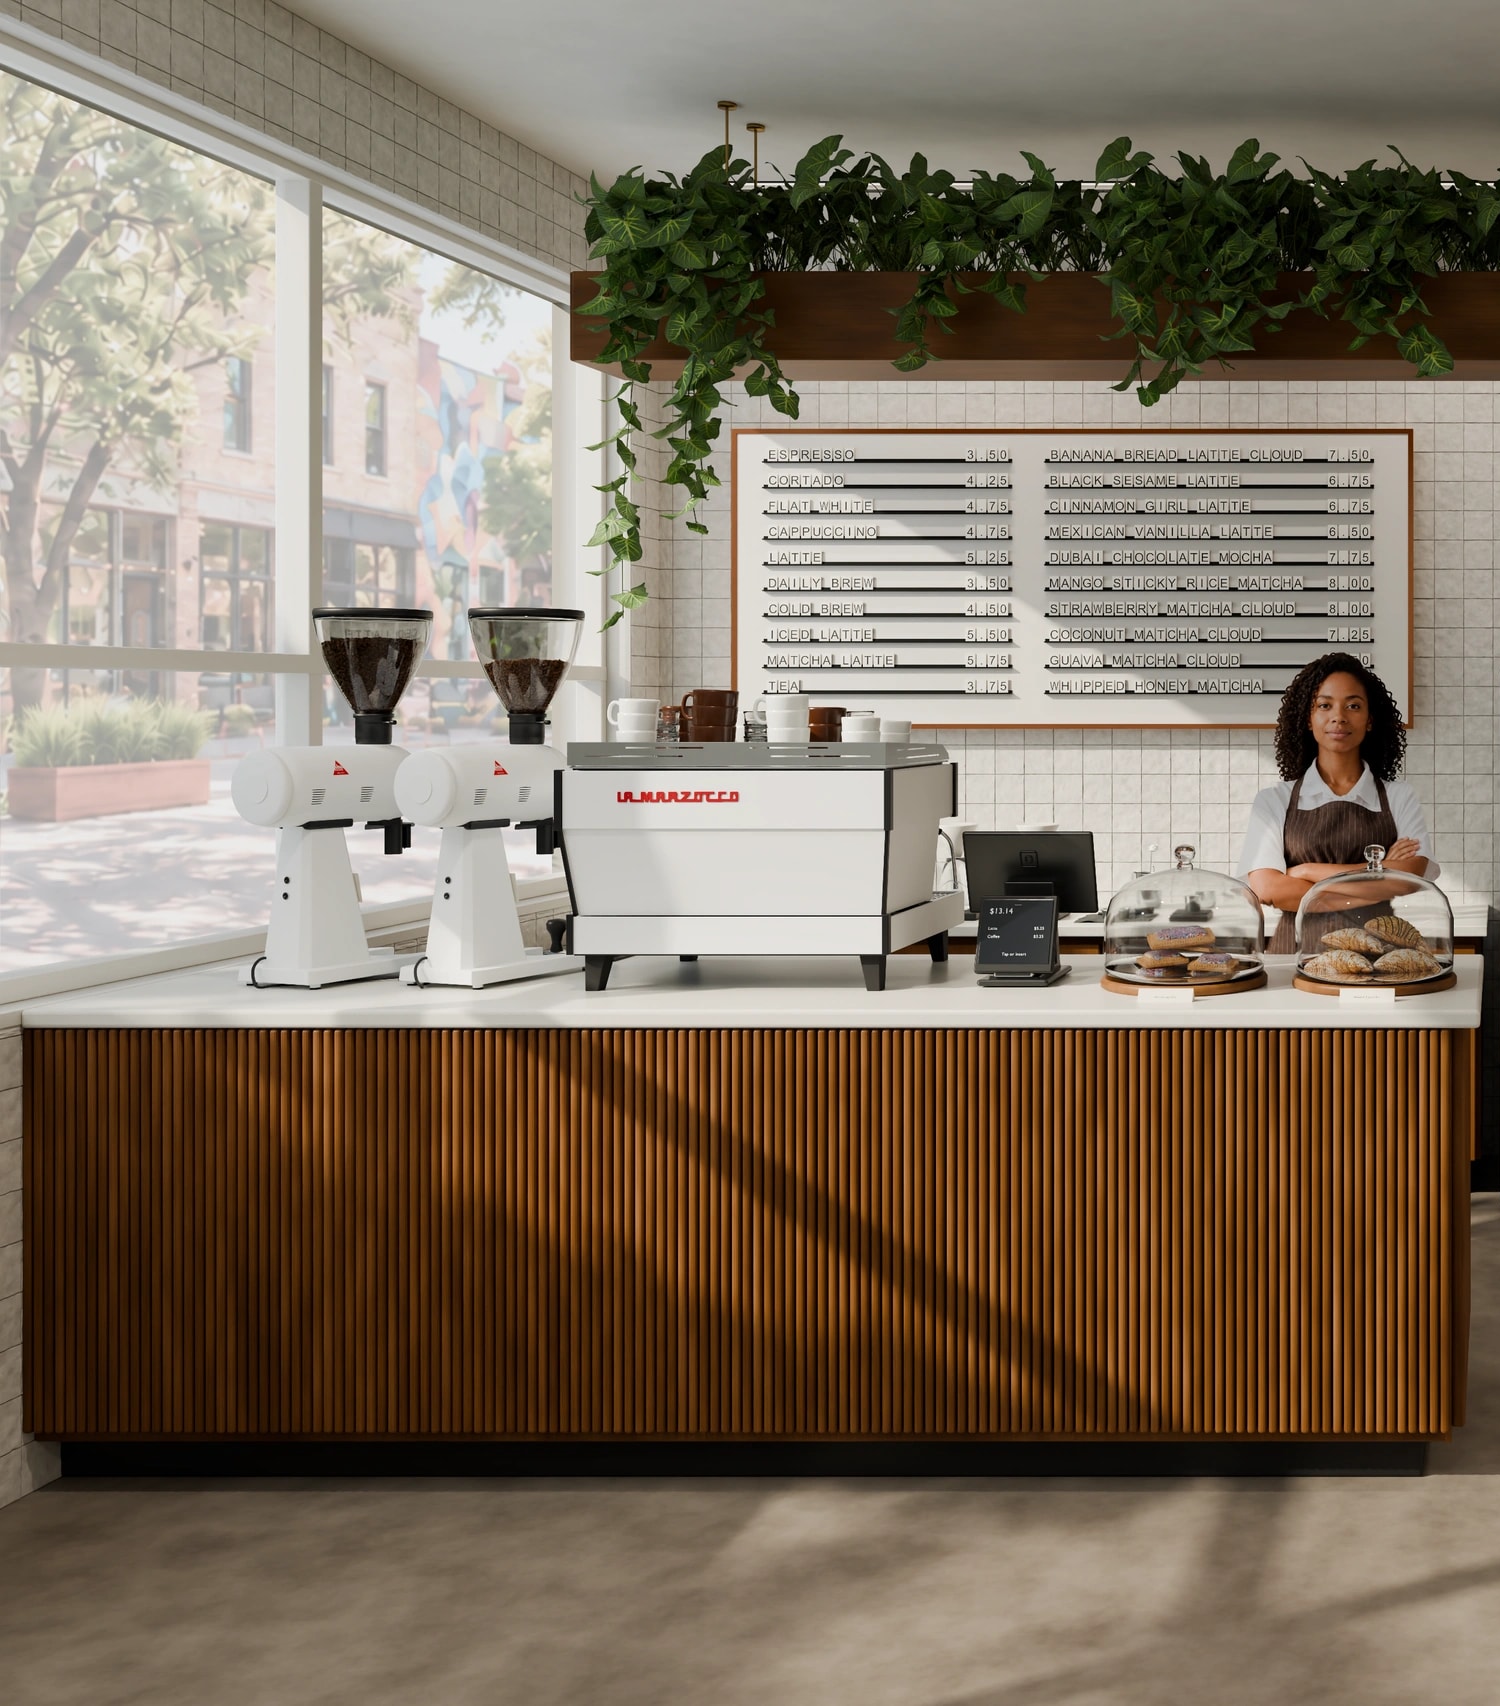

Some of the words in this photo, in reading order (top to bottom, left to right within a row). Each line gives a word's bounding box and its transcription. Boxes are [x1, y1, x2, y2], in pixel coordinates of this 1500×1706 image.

[768, 450, 855, 460] ESPRESSO
[966, 450, 1008, 460] 3.50
[1050, 450, 1114, 460] BANANA
[1125, 450, 1178, 460] BREAD
[1187, 450, 1240, 460] LATTE
[1249, 450, 1303, 460] CLOUD
[1328, 450, 1370, 460] 7.50
[768, 475, 844, 486] CORTADO
[966, 475, 1008, 486] 4.25
[1050, 475, 1103, 486] BLACK
[1113, 475, 1176, 486] SESAME
[1187, 475, 1239, 486] LATTE
[1328, 475, 1370, 486] 6.75
[768, 501, 809, 511] FLAT
[819, 501, 872, 511] WHITE
[966, 501, 1008, 511] 4.75
[1049, 501, 1136, 511] CINNAMON
[1145, 501, 1188, 511] GIRL
[1198, 501, 1250, 511] LATTE
[1328, 501, 1370, 511] 6.75
[768, 527, 877, 537] CAPPUCCINO
[966, 527, 1008, 537] 4.75
[1049, 527, 1126, 537] MEXICAN
[1134, 527, 1210, 537] VANILLA
[1221, 527, 1272, 537] LATTE
[1328, 527, 1370, 537] 6.50
[769, 553, 822, 563] LATTE
[966, 553, 1008, 563] 5.25
[1050, 553, 1101, 563] DUBAI
[1112, 553, 1210, 563] CHOCOLATE
[1219, 553, 1272, 563] MOCHA
[1328, 553, 1370, 563] 7.75
[768, 578, 821, 589] DAILY
[831, 578, 873, 589] BREW
[966, 578, 1008, 589] 3.50
[1049, 578, 1103, 589] MANGO
[1113, 578, 1177, 589] STICKY
[1186, 578, 1229, 589] RICE
[1237, 578, 1303, 589] MATCHA
[1328, 578, 1370, 589] 8.00
[768, 604, 810, 614] COLD
[820, 604, 864, 614] BREW
[966, 604, 1008, 614] 4.50
[1049, 604, 1158, 614] STRAWBERRY
[1167, 604, 1232, 614] MATCHA
[1241, 604, 1295, 614] CLOUD
[1328, 604, 1370, 614] 8.00
[770, 630, 810, 640] ICED
[820, 630, 872, 640] LATTE
[966, 630, 1008, 640] 5.50
[1049, 630, 1125, 640] COCONUT
[1134, 630, 1198, 640] MATCHA
[1207, 630, 1261, 640] CLOUD
[1328, 630, 1370, 640] 7.25
[767, 655, 832, 666] MATCHA
[842, 655, 894, 666] LATTE
[966, 655, 1008, 666] 5.75
[1049, 655, 1103, 666] GUAVA
[1112, 655, 1177, 666] MATCHA
[1186, 655, 1240, 666] CLOUD
[768, 681, 799, 691] TEA
[966, 681, 1008, 691] 3.75
[1049, 681, 1125, 691] WHIPPED
[1135, 681, 1188, 691] HONEY
[1198, 681, 1262, 691] MATCHA
[989, 907, 1014, 915] $13.14
